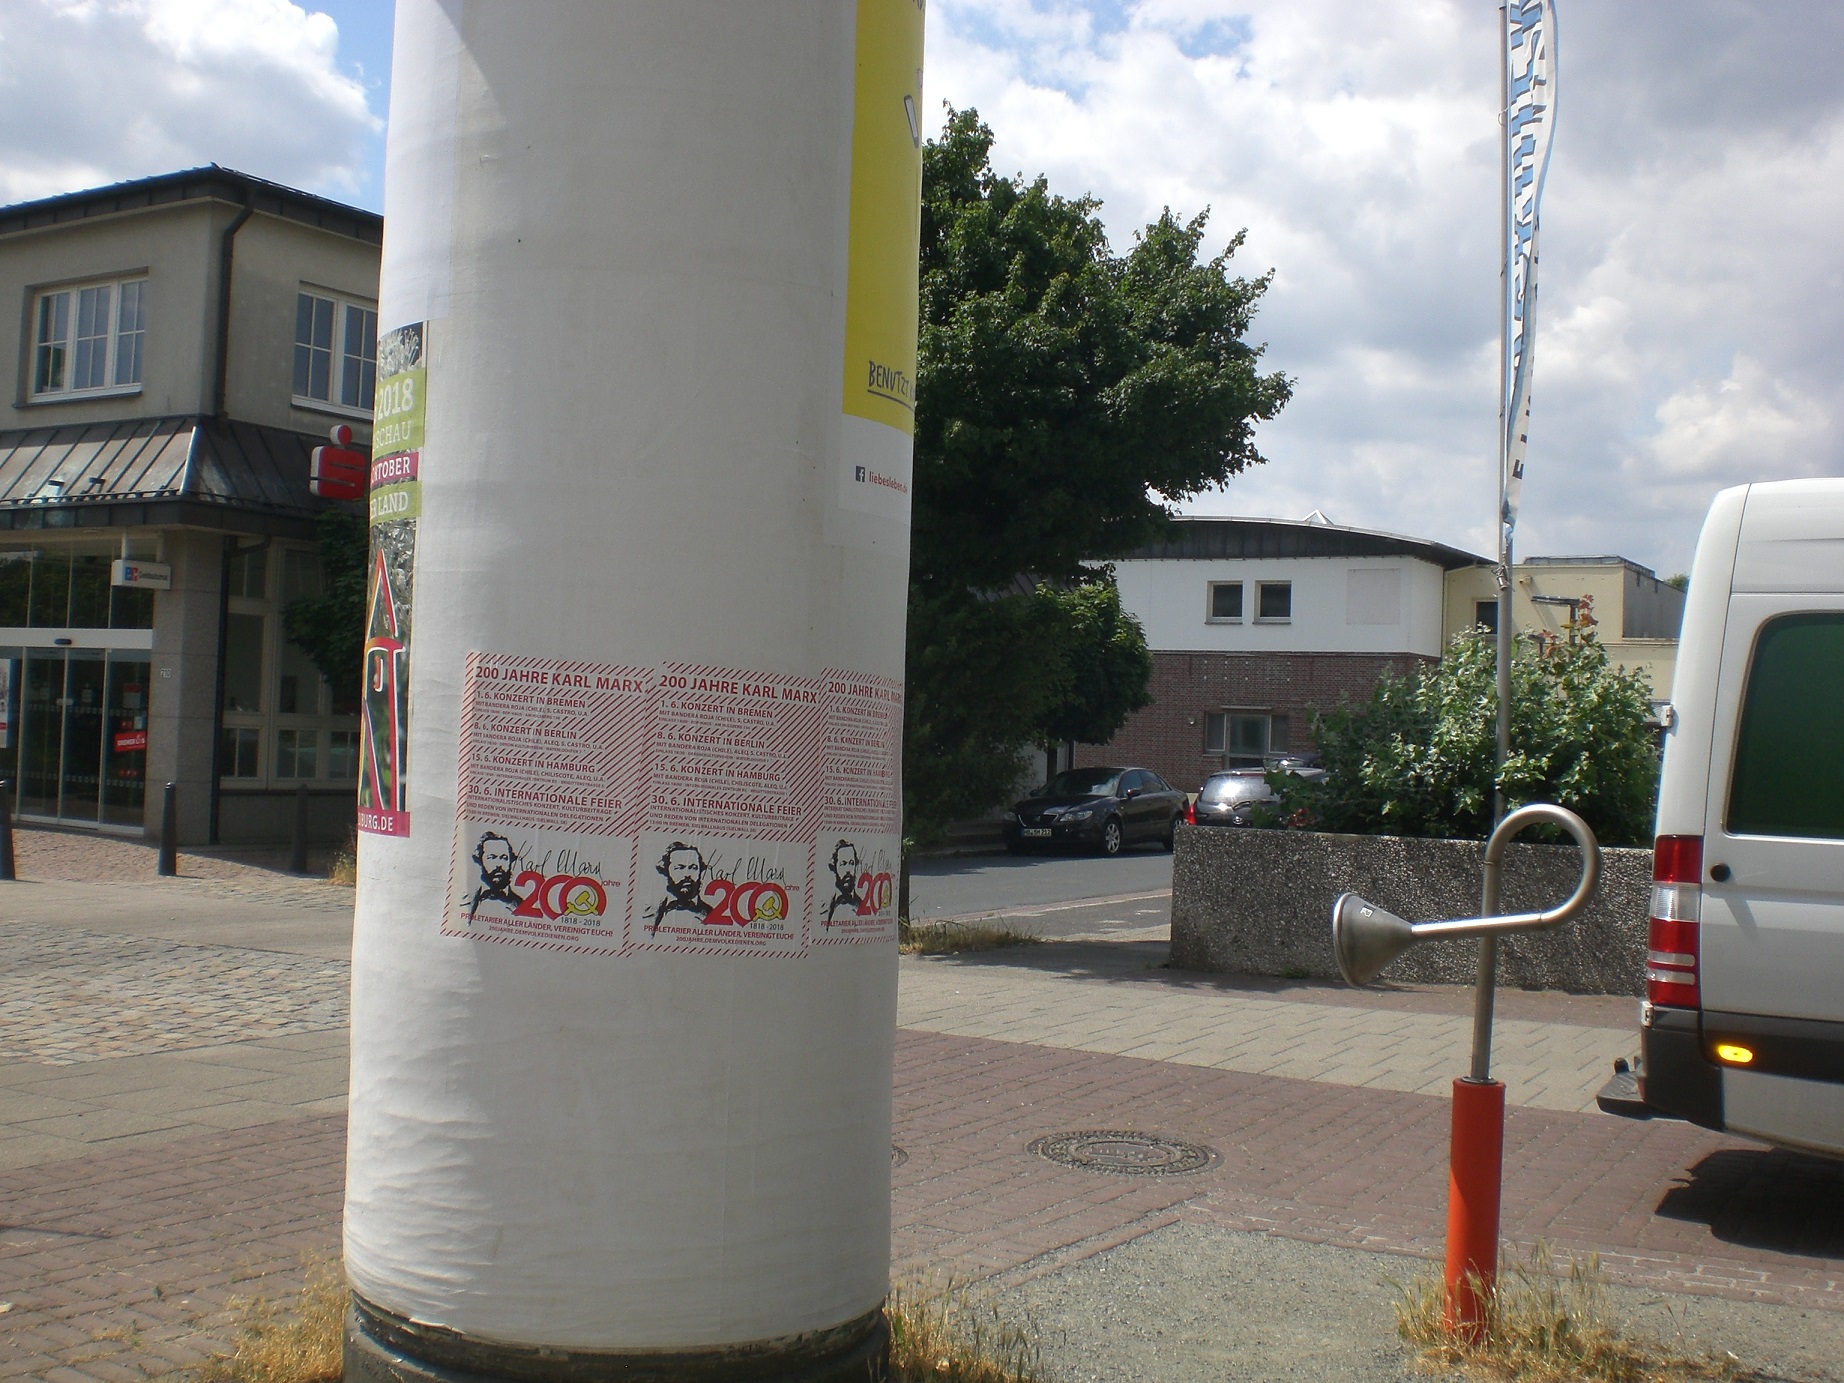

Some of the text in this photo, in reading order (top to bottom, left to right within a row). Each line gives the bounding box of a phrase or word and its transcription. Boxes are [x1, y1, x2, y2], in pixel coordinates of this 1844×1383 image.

[378, 378, 414, 420] 2018
[376, 420, 412, 448] SCHAU
[372, 456, 410, 483] KTOBER
[378, 492, 409, 516] LAND
[475, 666, 643, 693] 200 JAHRE KARL MARX
[659, 675, 818, 704] 200 JAHRE KARL MARX
[828, 682, 846, 694] 200
[848, 684, 873, 698] JAHRE
[494, 692, 534, 703] KONZERT
[546, 698, 586, 708] BREMEN
[681, 702, 724, 713] KONZERT
[726, 707, 735, 715] IN
[737, 708, 773, 718] BREMEN
[843, 707, 866, 716] KONZERT
[491, 724, 531, 734] KONZERT
[544, 729, 577, 739] BERLIN
[678, 733, 721, 744] KONZERT
[723, 738, 732, 746] IN
[734, 739, 765, 749] BERLIN
[472, 754, 482, 762] 15.
[493, 756, 533, 767] KONZERT
[547, 761, 595, 773] HAMBURG
[655, 763, 668, 771] 15.
[681, 765, 723, 776] KONZERT
[737, 771, 780, 781] HAMBURG
[468, 785, 622, 809] 30. 6. INTERNATIONALE FEIER
[651, 795, 802, 815] 30. 6. INTERNATIONALE FEIER
[825, 796, 844, 805] 30. 6.
[360, 812, 393, 832] BURG.DE
[560, 813, 604, 822] DELEGATIONEN
[512, 871, 607, 921] 200
[702, 880, 789, 928] 200
[503, 919, 523, 928] ALLER
[554, 926, 591, 935] VEREINIGT
